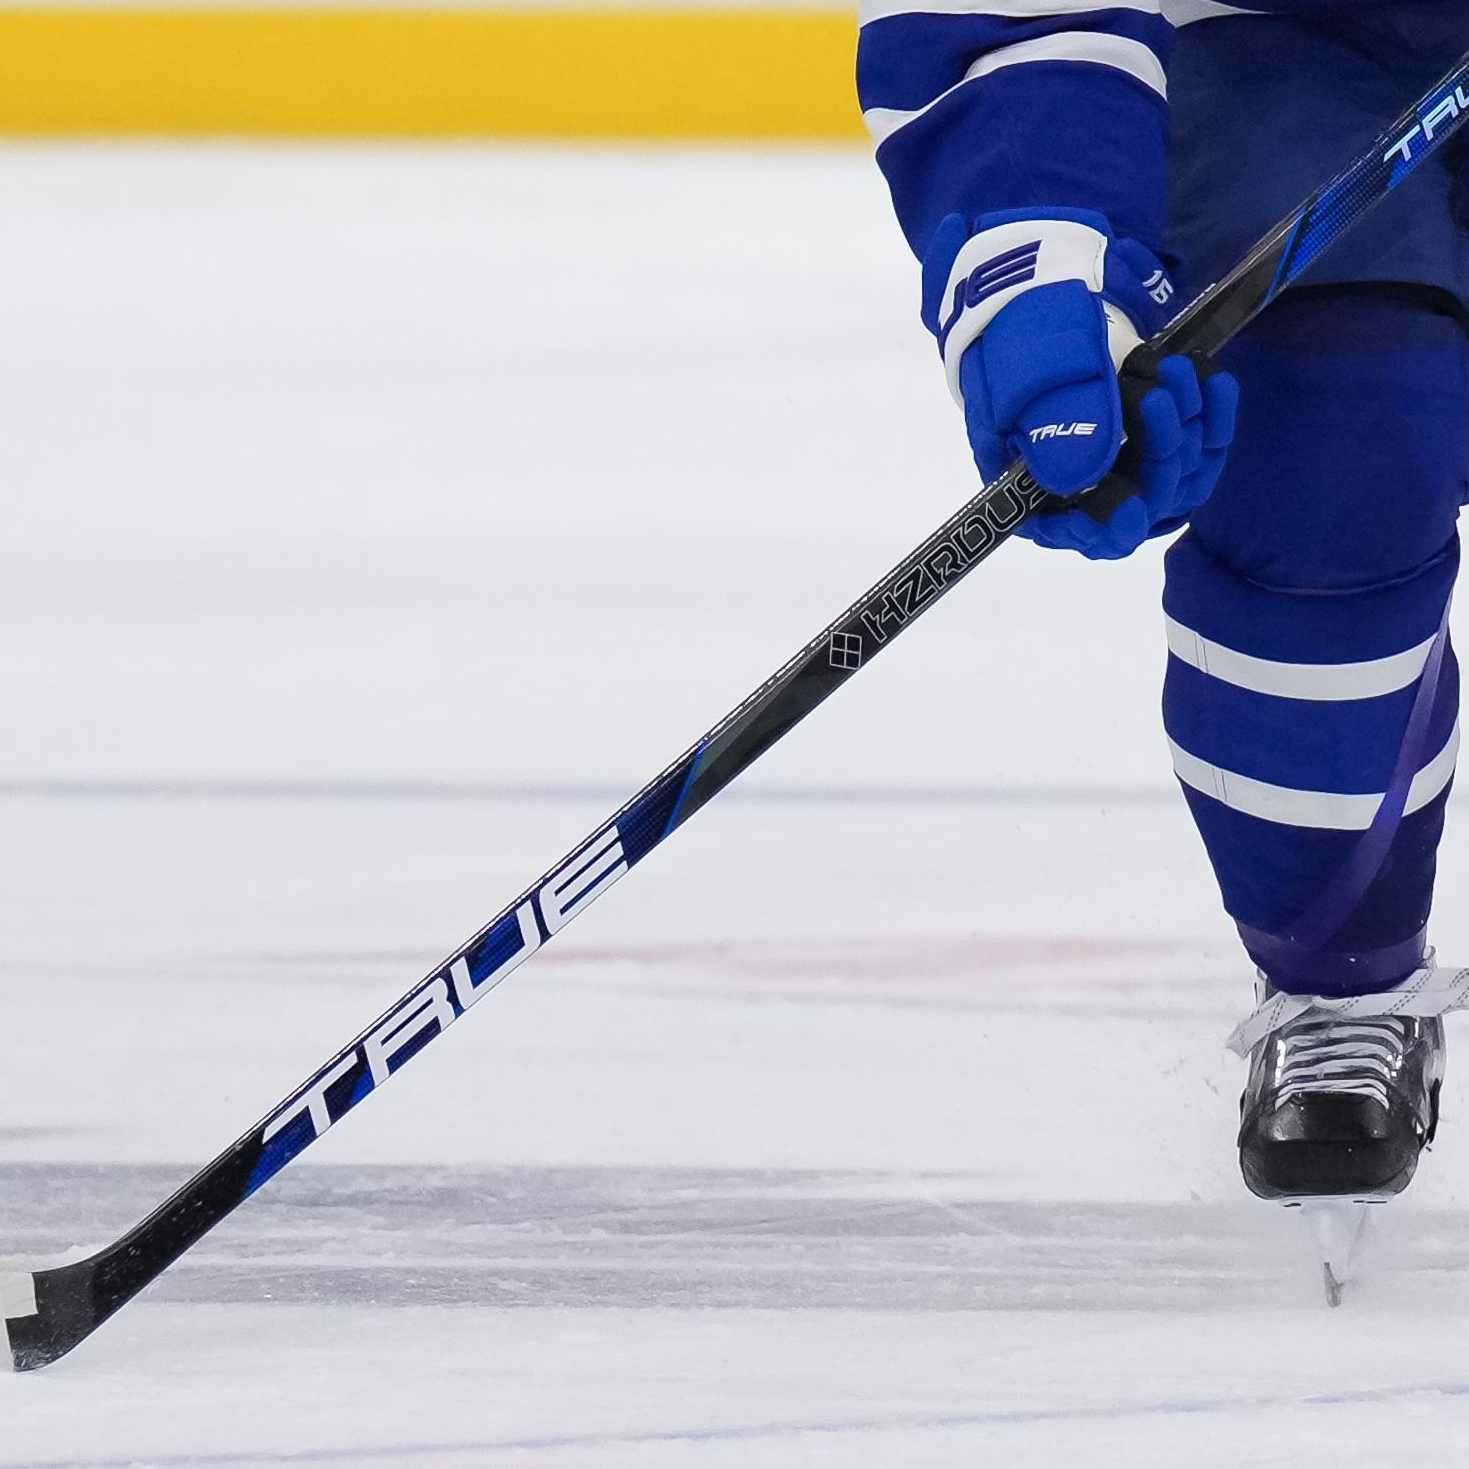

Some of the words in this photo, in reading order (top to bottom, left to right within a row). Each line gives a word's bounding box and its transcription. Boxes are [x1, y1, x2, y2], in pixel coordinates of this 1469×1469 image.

[1142, 269, 1174, 305] 16
[1029, 421, 1098, 443] TRUE
[260, 824, 629, 1146] TRUE
